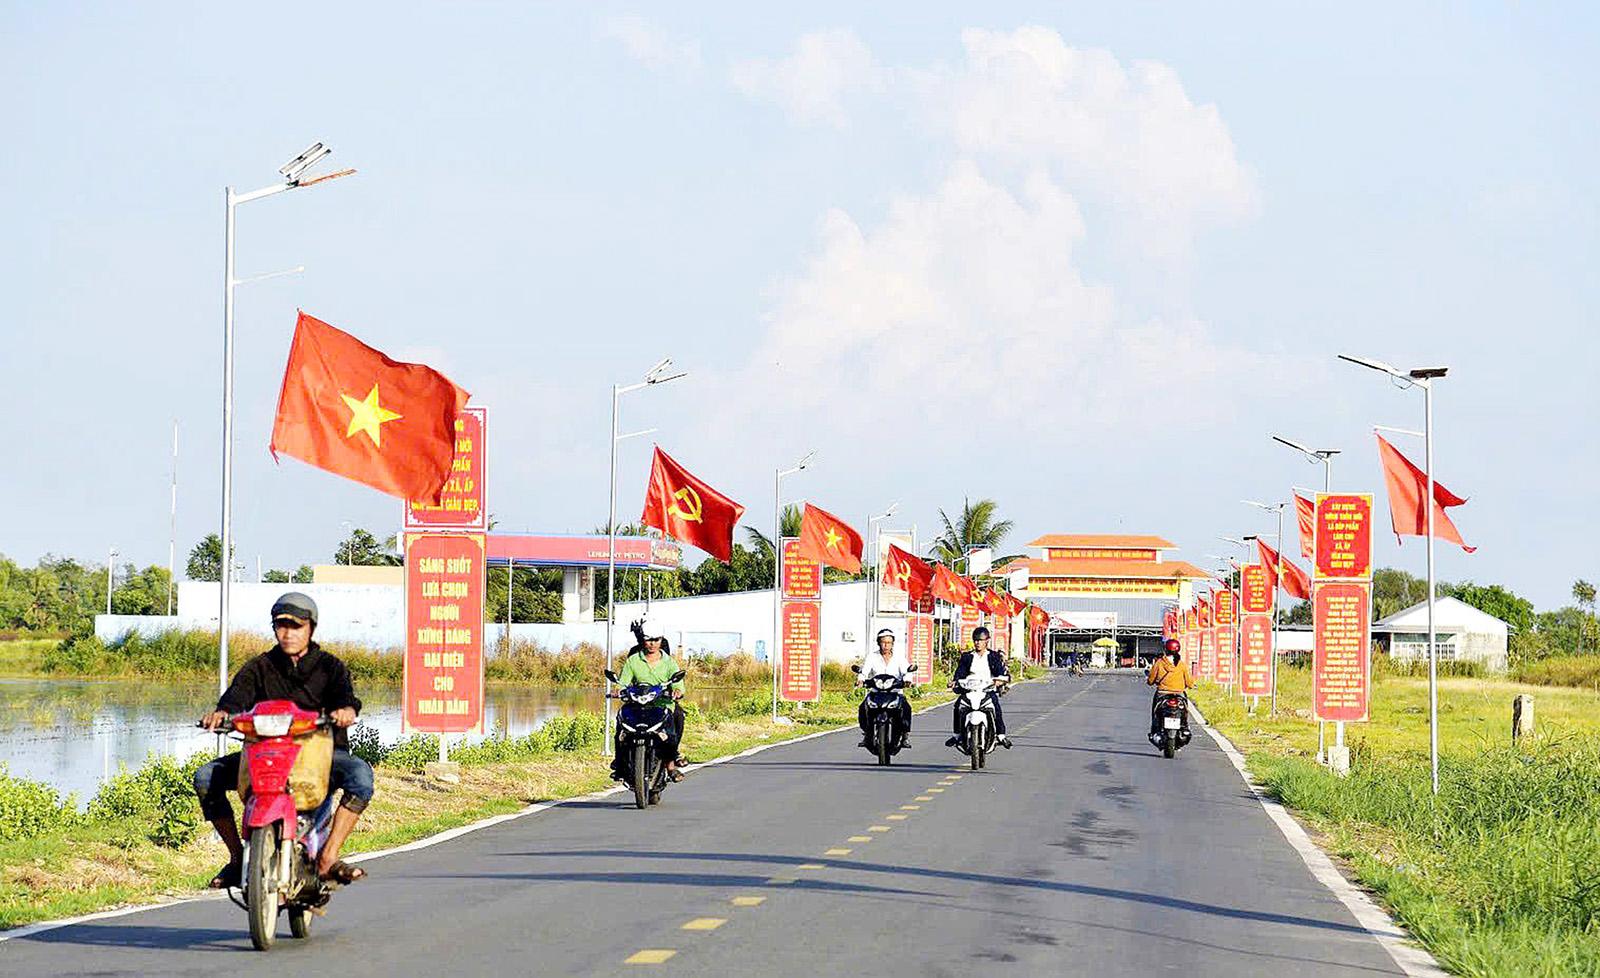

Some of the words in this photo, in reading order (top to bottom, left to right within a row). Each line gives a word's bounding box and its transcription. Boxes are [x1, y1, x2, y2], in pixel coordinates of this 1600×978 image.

[419, 556, 445, 573] SÁNG
[447, 554, 472, 574] SUỐT
[441, 581, 468, 600] CHỌN
[434, 675, 454, 692] CHO
